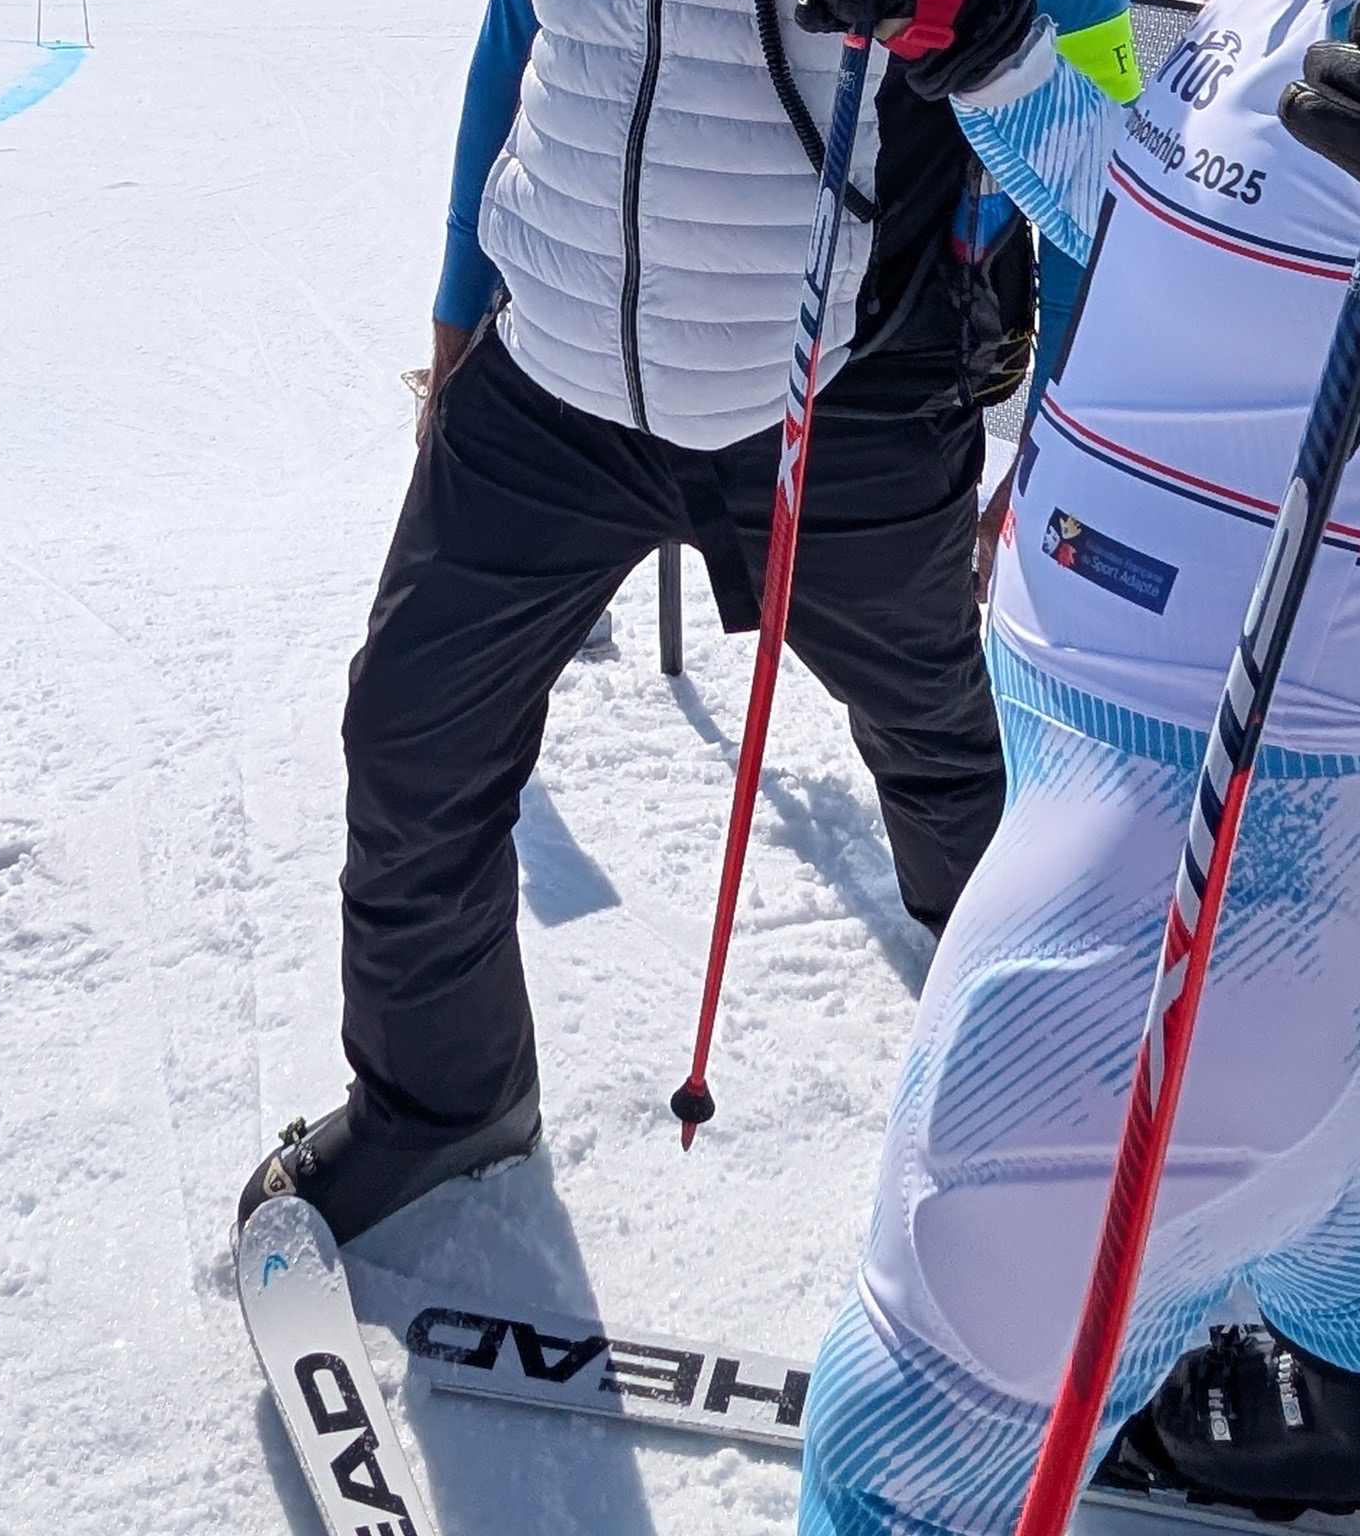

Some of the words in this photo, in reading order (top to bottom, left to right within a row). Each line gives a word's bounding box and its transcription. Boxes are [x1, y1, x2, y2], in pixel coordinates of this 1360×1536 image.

[1112, 44, 1128, 75] F
[1185, 149, 1267, 205] 2025
[406, 1306, 812, 1427] HEAD
[293, 1352, 420, 1536] AD
